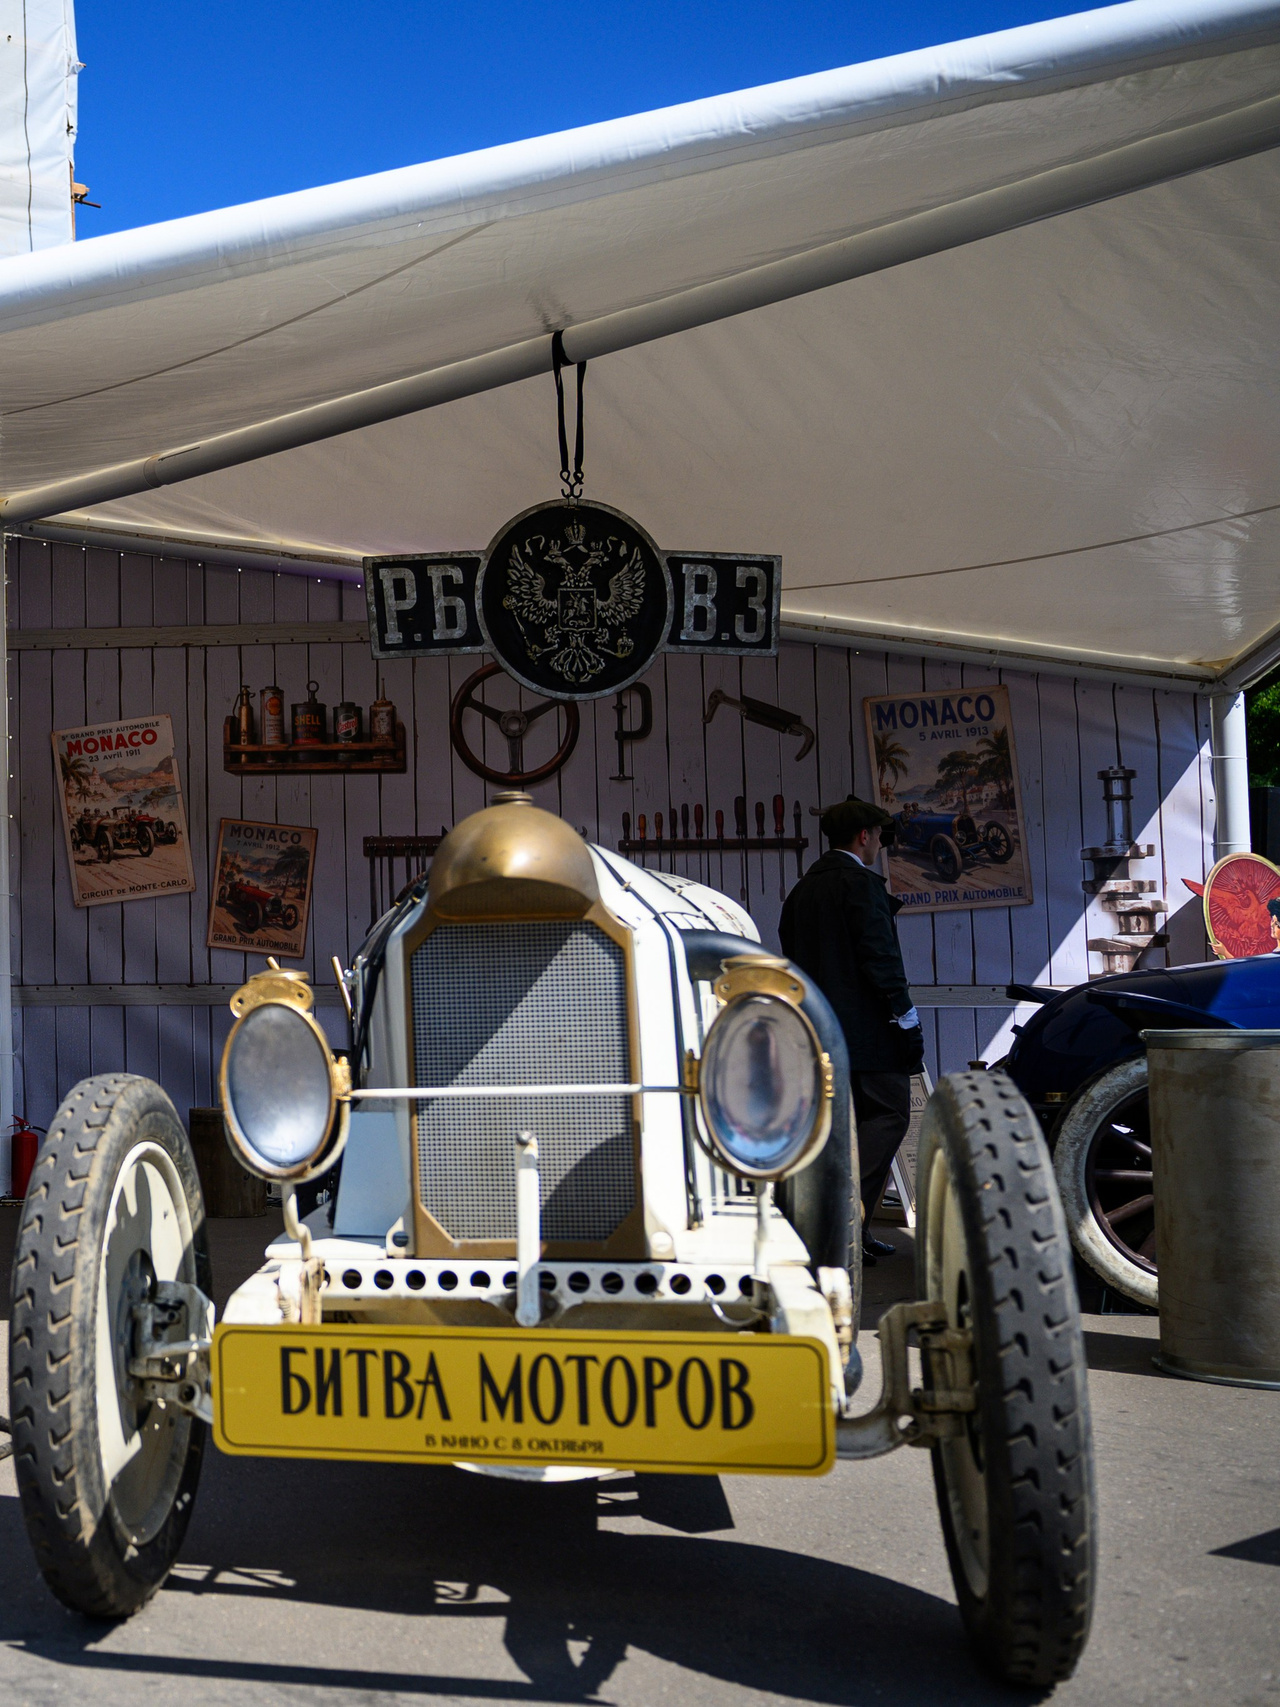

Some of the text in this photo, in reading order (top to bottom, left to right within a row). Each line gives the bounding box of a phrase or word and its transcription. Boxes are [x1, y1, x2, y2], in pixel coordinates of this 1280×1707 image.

[294, 714, 321, 725] SHELL
[875, 694, 996, 731] MONACO
[70, 730, 95, 740] GRAND
[97, 727, 114, 736] PRIX
[116, 720, 161, 732] AUTOMOBILE
[918, 726, 989, 742] 5 AVRIL 1913
[66, 728, 158, 758] MONACO
[88, 754, 100, 763] 23
[125, 748, 141, 757] 1911
[229, 825, 302, 845] MONACO
[243, 840, 263, 849] AVRIL
[265, 843, 281, 851] 1912
[81, 889, 115, 900] CIRCUIT
[129, 878, 188, 893] MONTE-CARLO
[935, 889, 960, 903] PRIX
[962, 886, 1024, 900] AUTOMOBILE
[213, 933, 298, 952] GRAND PRIX AUTOMOBILE
[279, 1346, 754, 1431] БИТВА МОТОРОВ
[441, 1434, 489, 1449] КИНО
[493, 1435, 508, 1450] С
[527, 1437, 604, 1454] ОКТЯБРЯ
